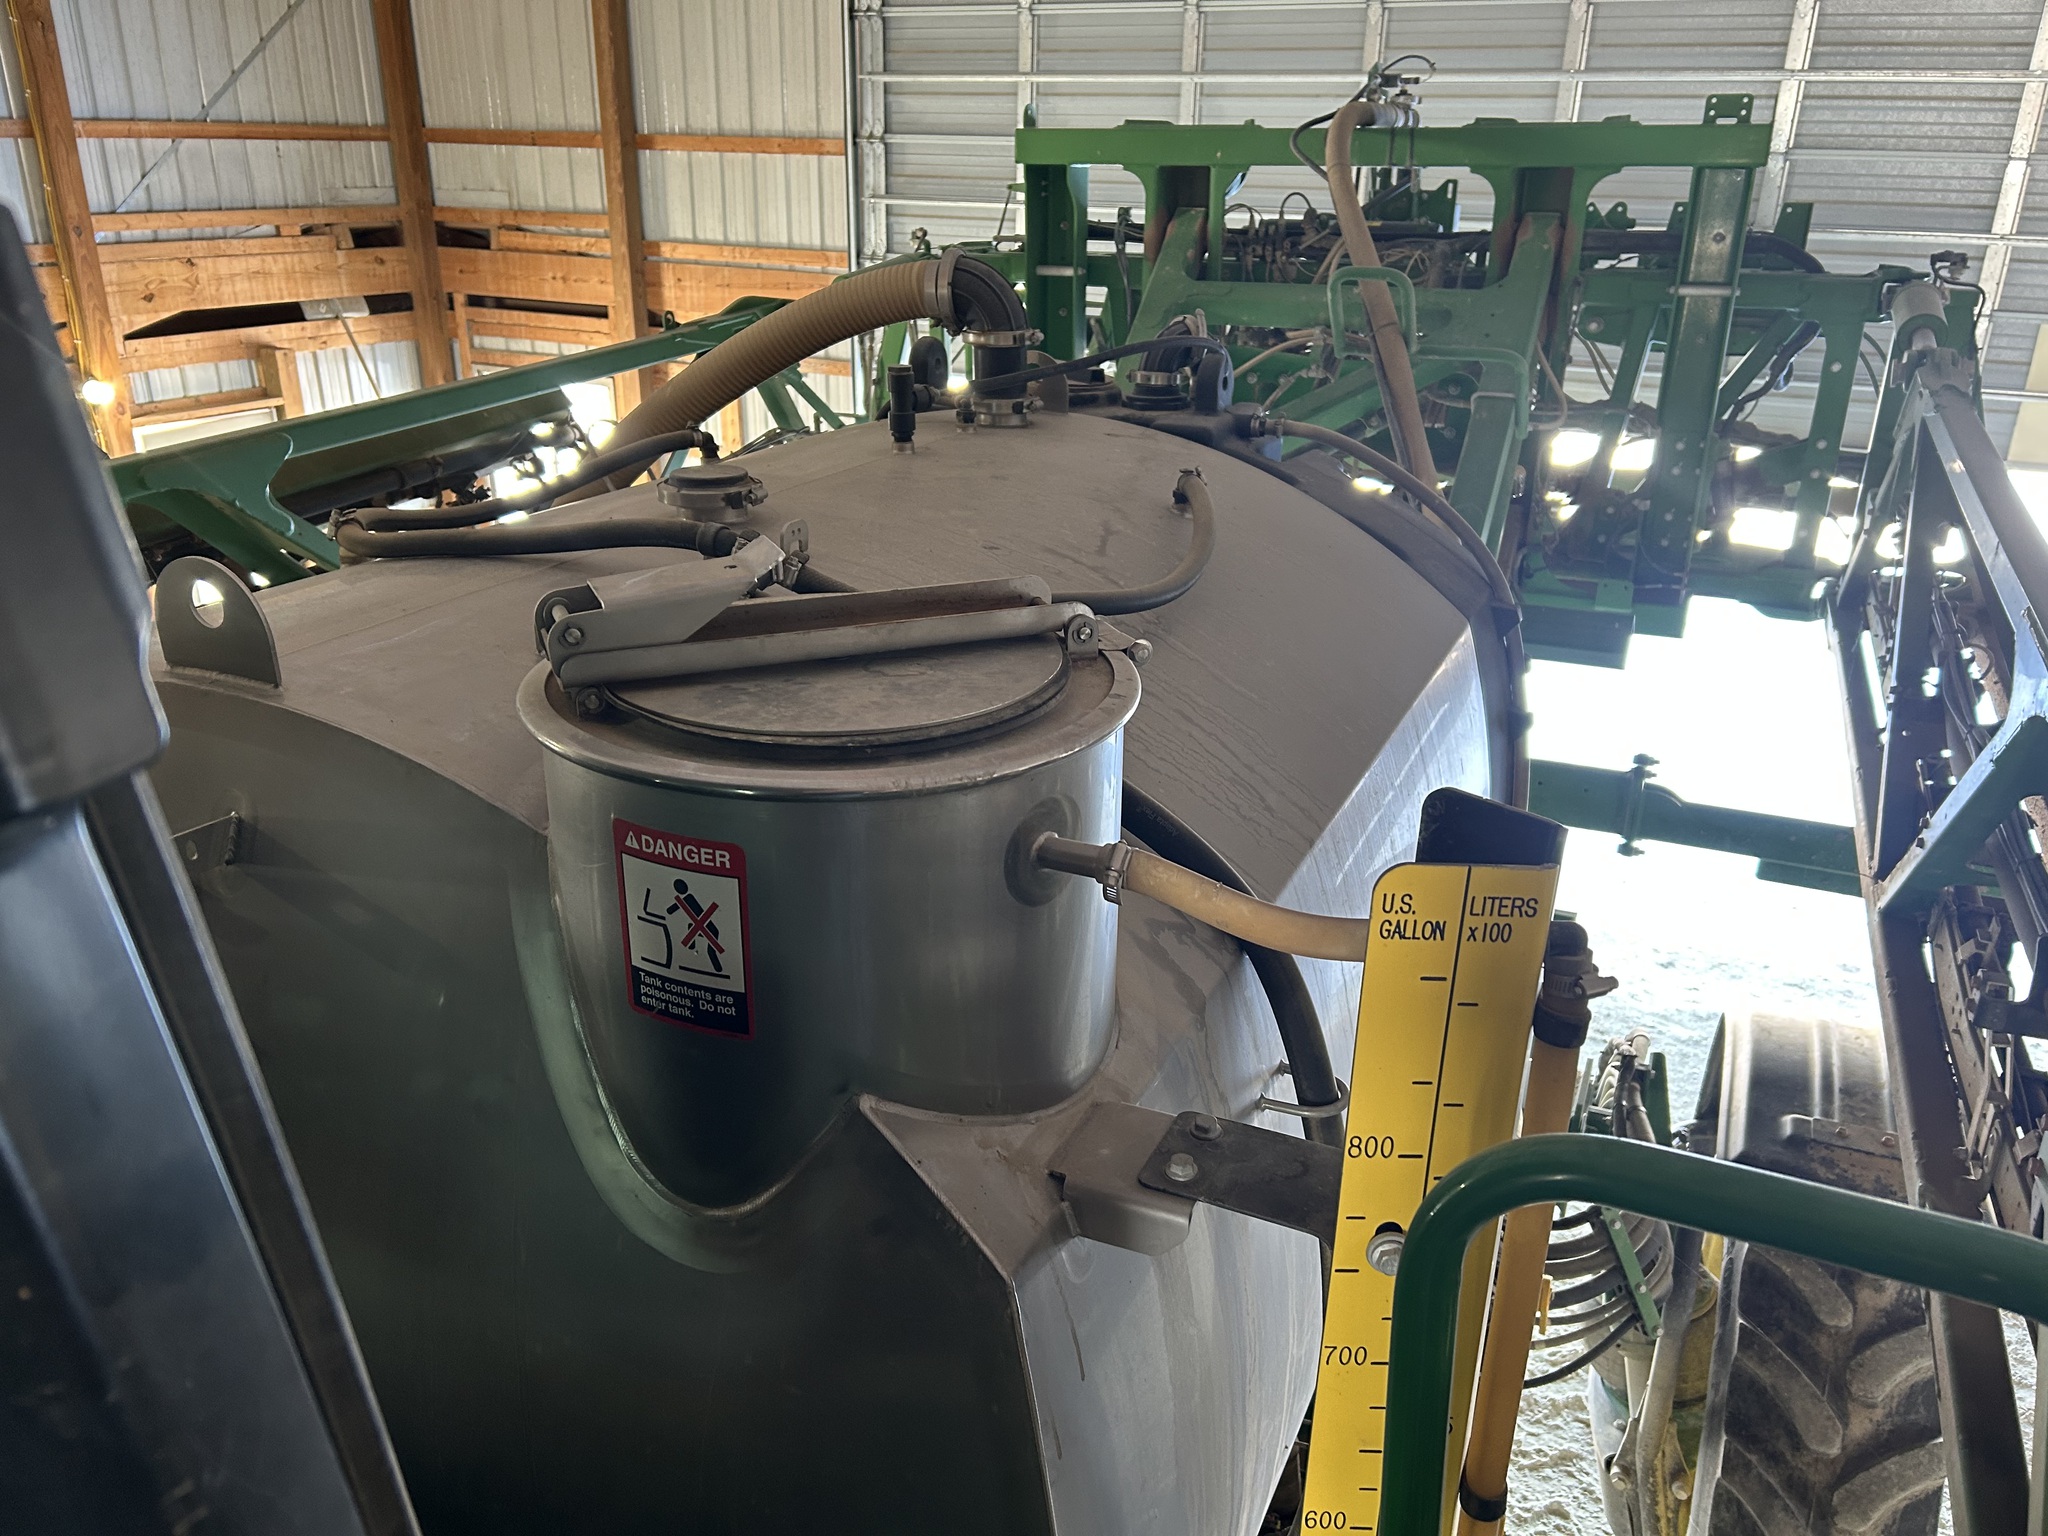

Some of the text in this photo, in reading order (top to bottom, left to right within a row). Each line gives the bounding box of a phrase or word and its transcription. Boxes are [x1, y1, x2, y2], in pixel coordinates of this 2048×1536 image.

[641, 834, 731, 869] DANGER
[1381, 893, 1416, 915] U.S.
[1469, 896, 1539, 918] LITERS
[1379, 919, 1447, 942] GALLON
[1466, 922, 1513, 943] x100
[639, 971, 734, 1005] Tank contents are
[640, 984, 737, 1017] poisonous. Do not
[641, 995, 695, 1019] enter tank.
[1347, 1135, 1395, 1160] 800
[1323, 1346, 1368, 1367] 700
[1304, 1510, 1347, 1530] 600
